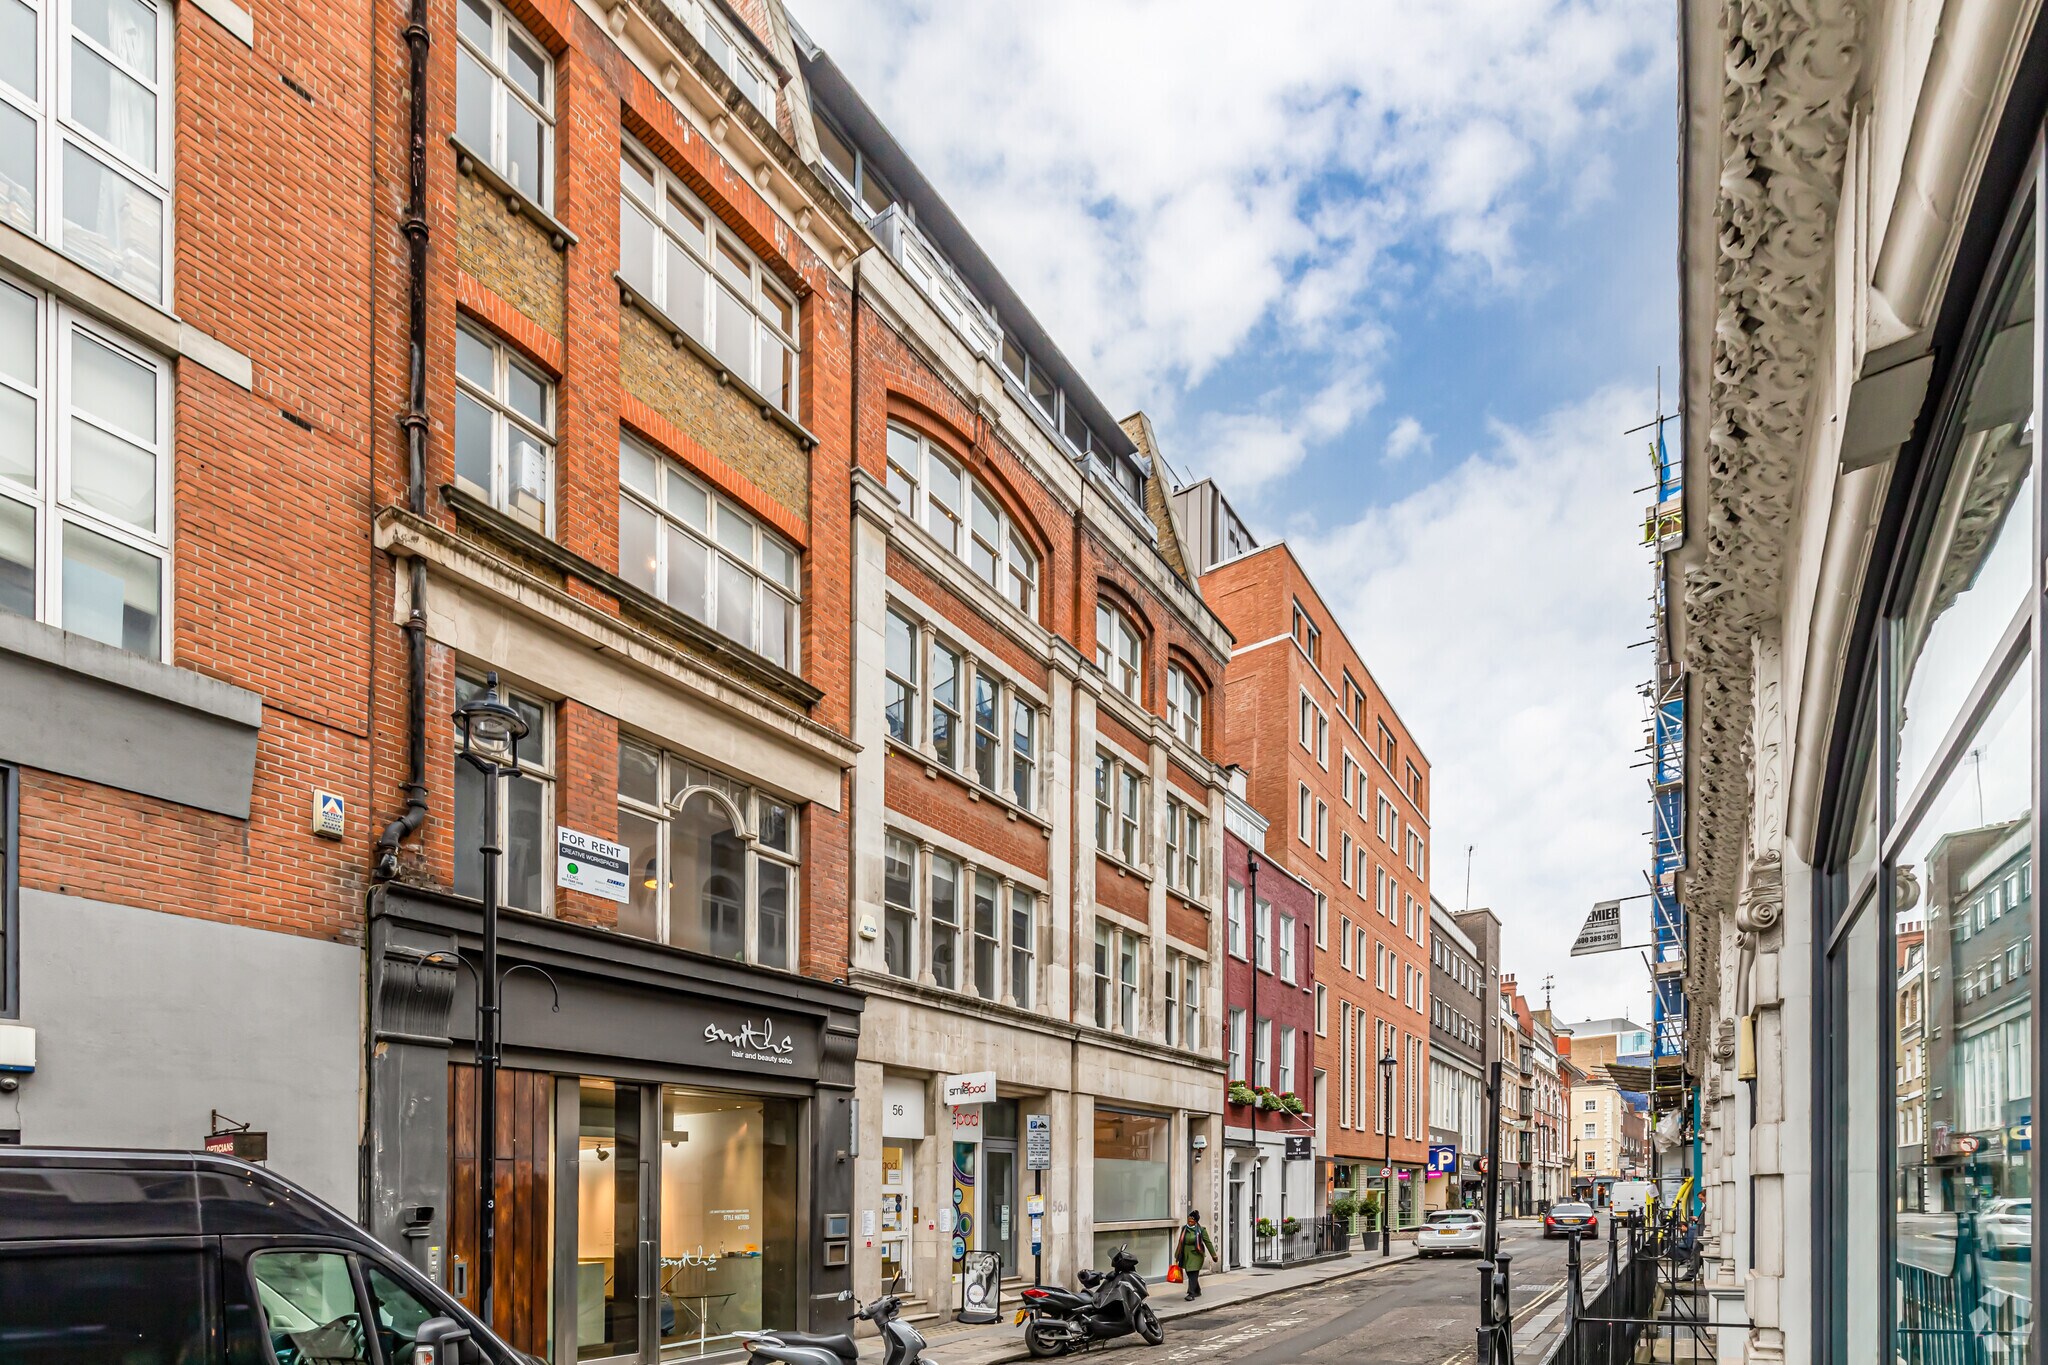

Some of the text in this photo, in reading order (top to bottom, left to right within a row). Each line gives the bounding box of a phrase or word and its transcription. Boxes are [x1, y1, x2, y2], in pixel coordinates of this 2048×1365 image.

[561, 832, 621, 858] FOR RENT
[561, 847, 620, 869] CREATIVE WORKSPACES
[1589, 935, 1602, 943] 389
[1602, 933, 1618, 941] 3920
[731, 1050, 793, 1065] hair and beauty soho
[949, 1082, 987, 1096] smilepod
[892, 1104, 904, 1116] 56
[206, 1142, 234, 1153] OPTICIANS
[1438, 1151, 1454, 1171] P
[487, 1200, 494, 1209] 3
[1052, 1200, 1068, 1213] 56A
